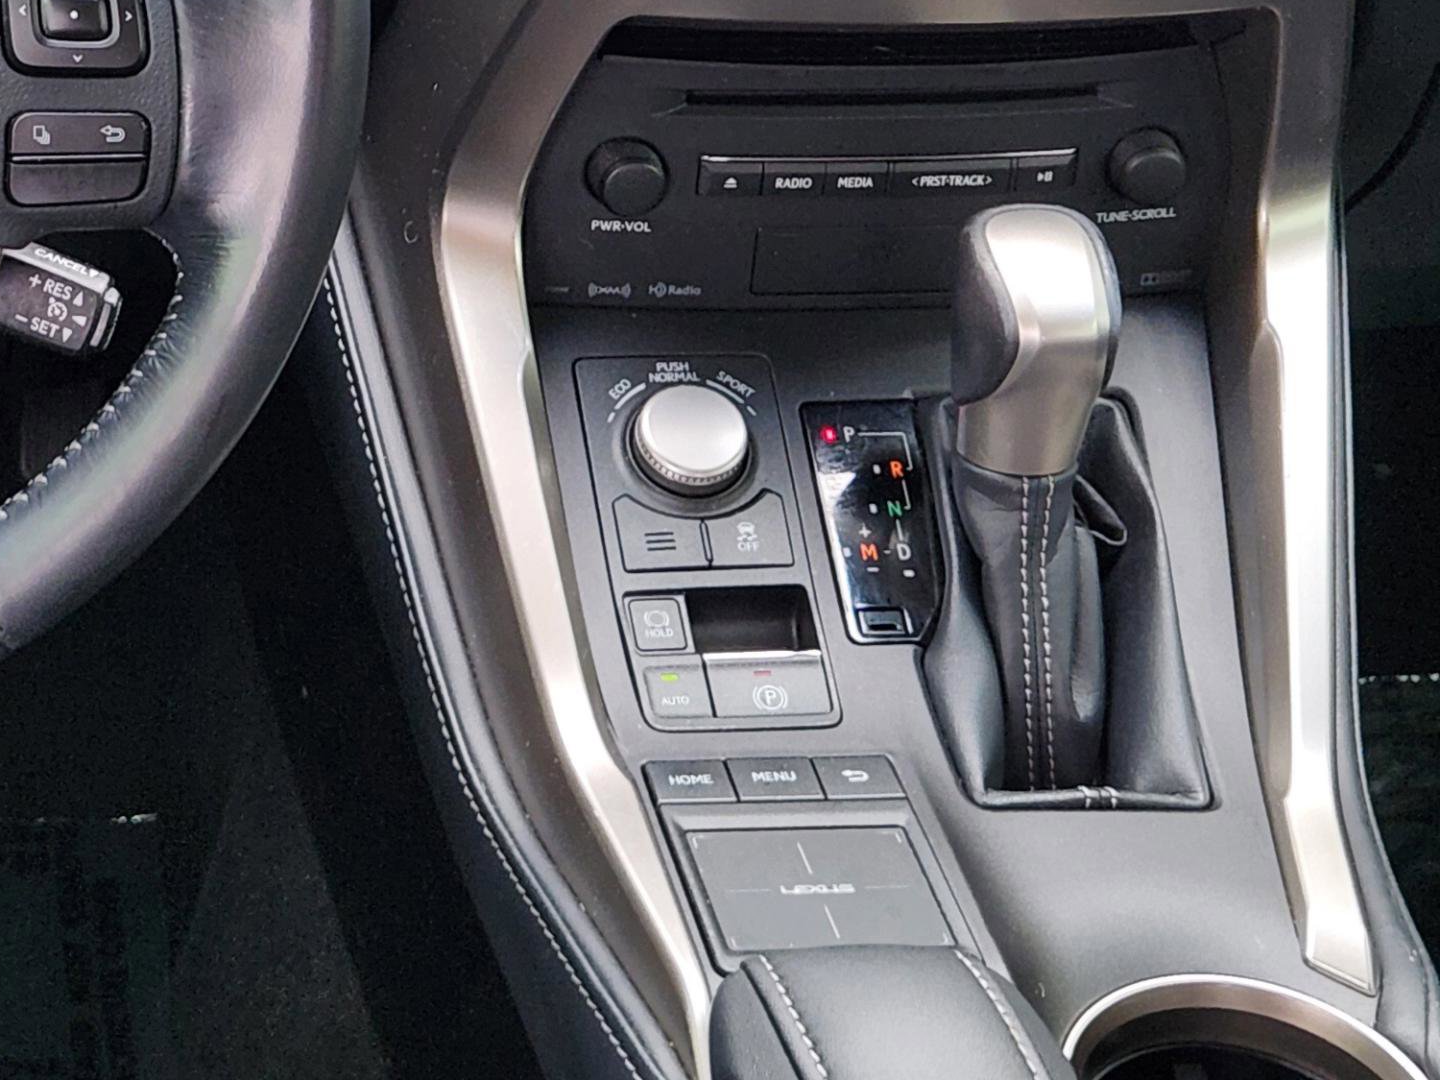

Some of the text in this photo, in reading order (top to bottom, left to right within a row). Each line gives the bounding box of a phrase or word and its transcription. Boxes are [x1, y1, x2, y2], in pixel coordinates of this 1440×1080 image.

[775, 177, 812, 189] RADIO
[838, 176, 873, 189] MEDIA
[34, 248, 88, 276] CANCEL
[668, 285, 701, 295] Radio
[656, 361, 689, 372] PUSH
[648, 372, 701, 383] NORMAL
[608, 378, 632, 401] ECO
[716, 371, 756, 398] SPORT
[843, 426, 855, 443] P
[890, 460, 904, 478] R
[887, 500, 903, 517] N
[737, 542, 760, 553] OFF
[860, 543, 878, 561] M
[896, 543, 911, 560] D
[645, 627, 673, 638] HOLD
[662, 695, 689, 706] AUTO
[669, 774, 713, 786] HOME
[751, 771, 796, 783] MENU
